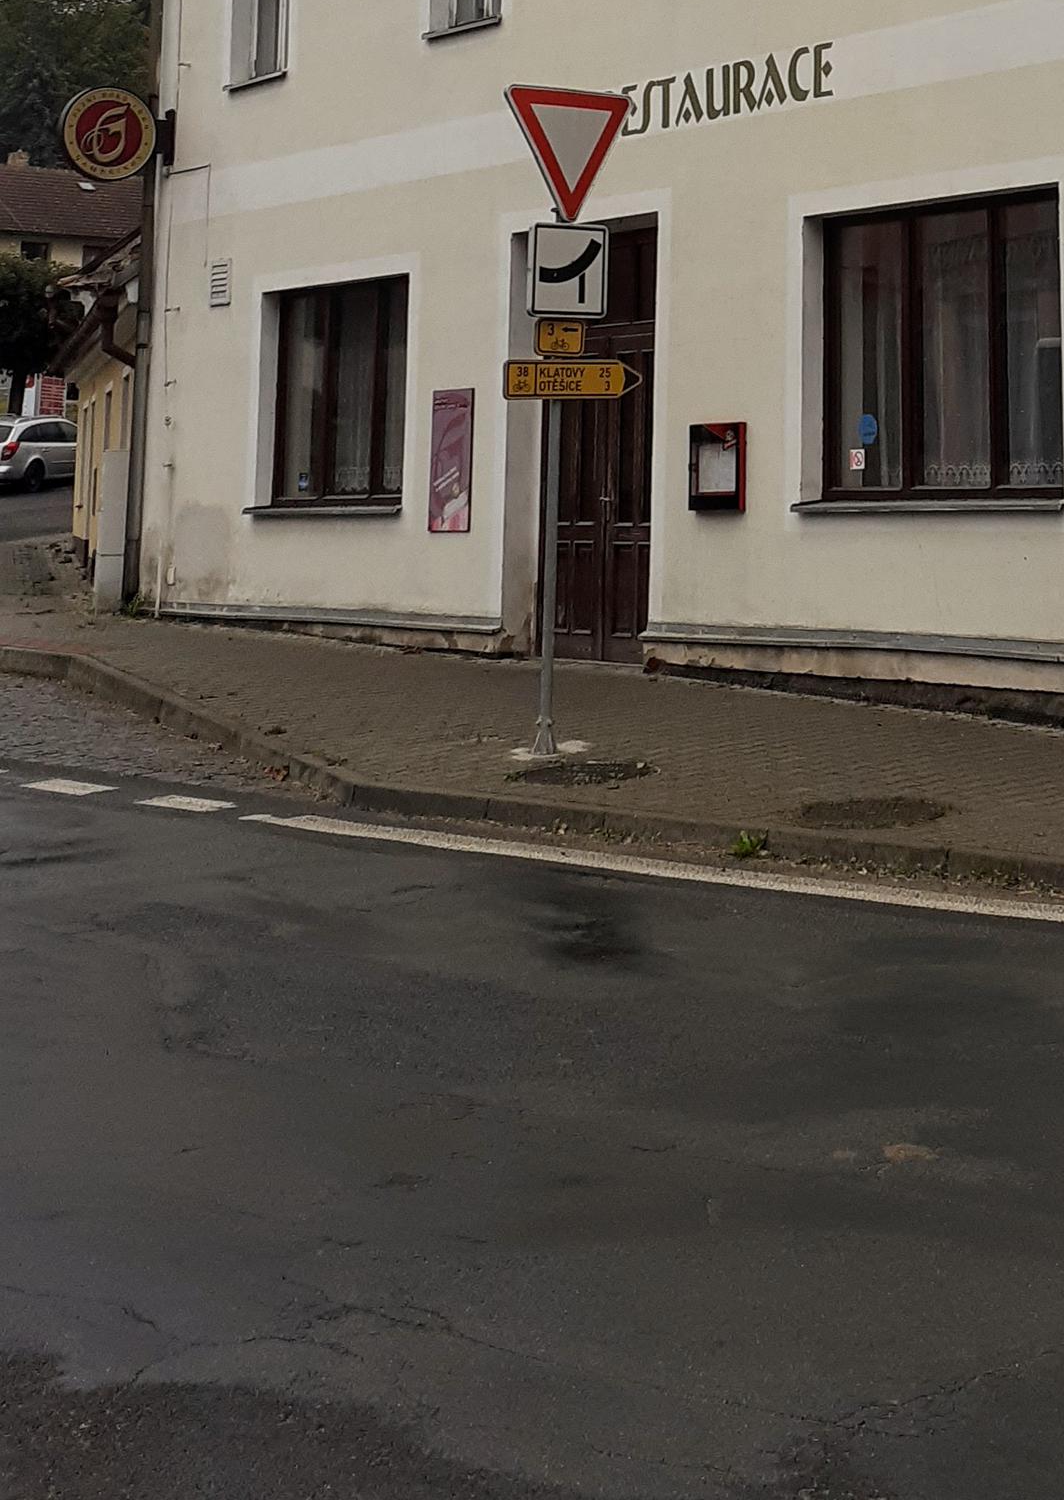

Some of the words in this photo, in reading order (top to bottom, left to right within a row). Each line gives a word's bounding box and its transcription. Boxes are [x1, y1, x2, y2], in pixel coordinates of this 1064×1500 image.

[605, 41, 834, 137] ESTAURACE
[547, 323, 555, 336] 3
[517, 366, 529, 377] 38
[539, 367, 586, 378] KLATOVY
[599, 367, 611, 378] 25
[539, 379, 582, 392] OTĚŠICE
[605, 381, 611, 391] 3
